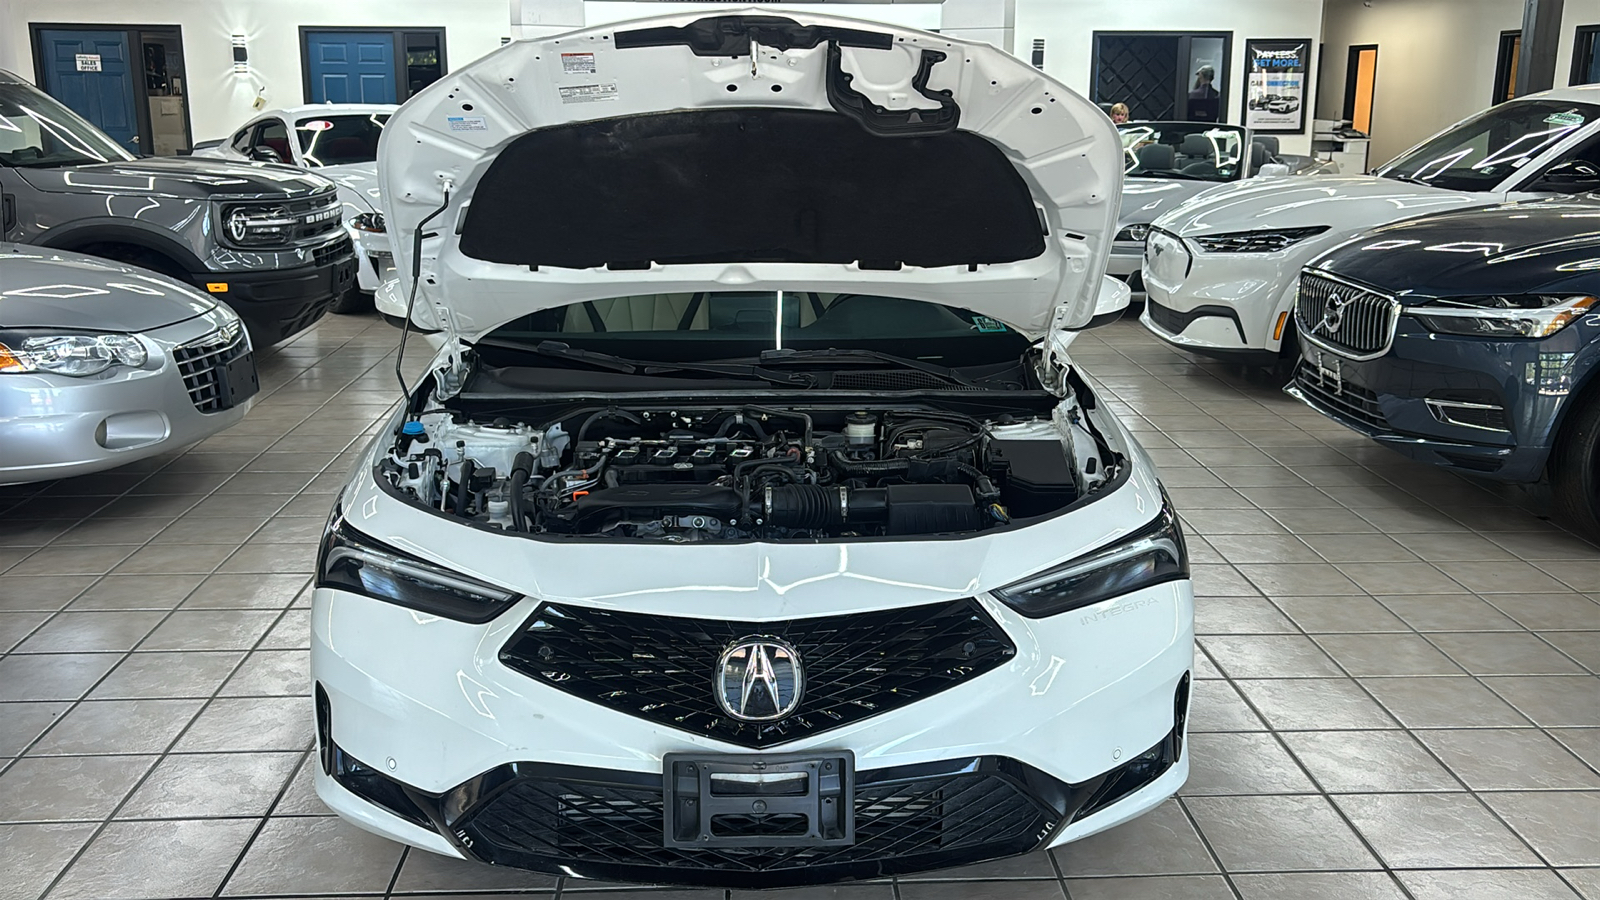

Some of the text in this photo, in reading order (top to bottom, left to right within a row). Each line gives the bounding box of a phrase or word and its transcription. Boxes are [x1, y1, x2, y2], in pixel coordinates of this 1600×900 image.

[1253, 59, 1302, 67] GET MORE.
[1080, 597, 1160, 626] INTEGRA
